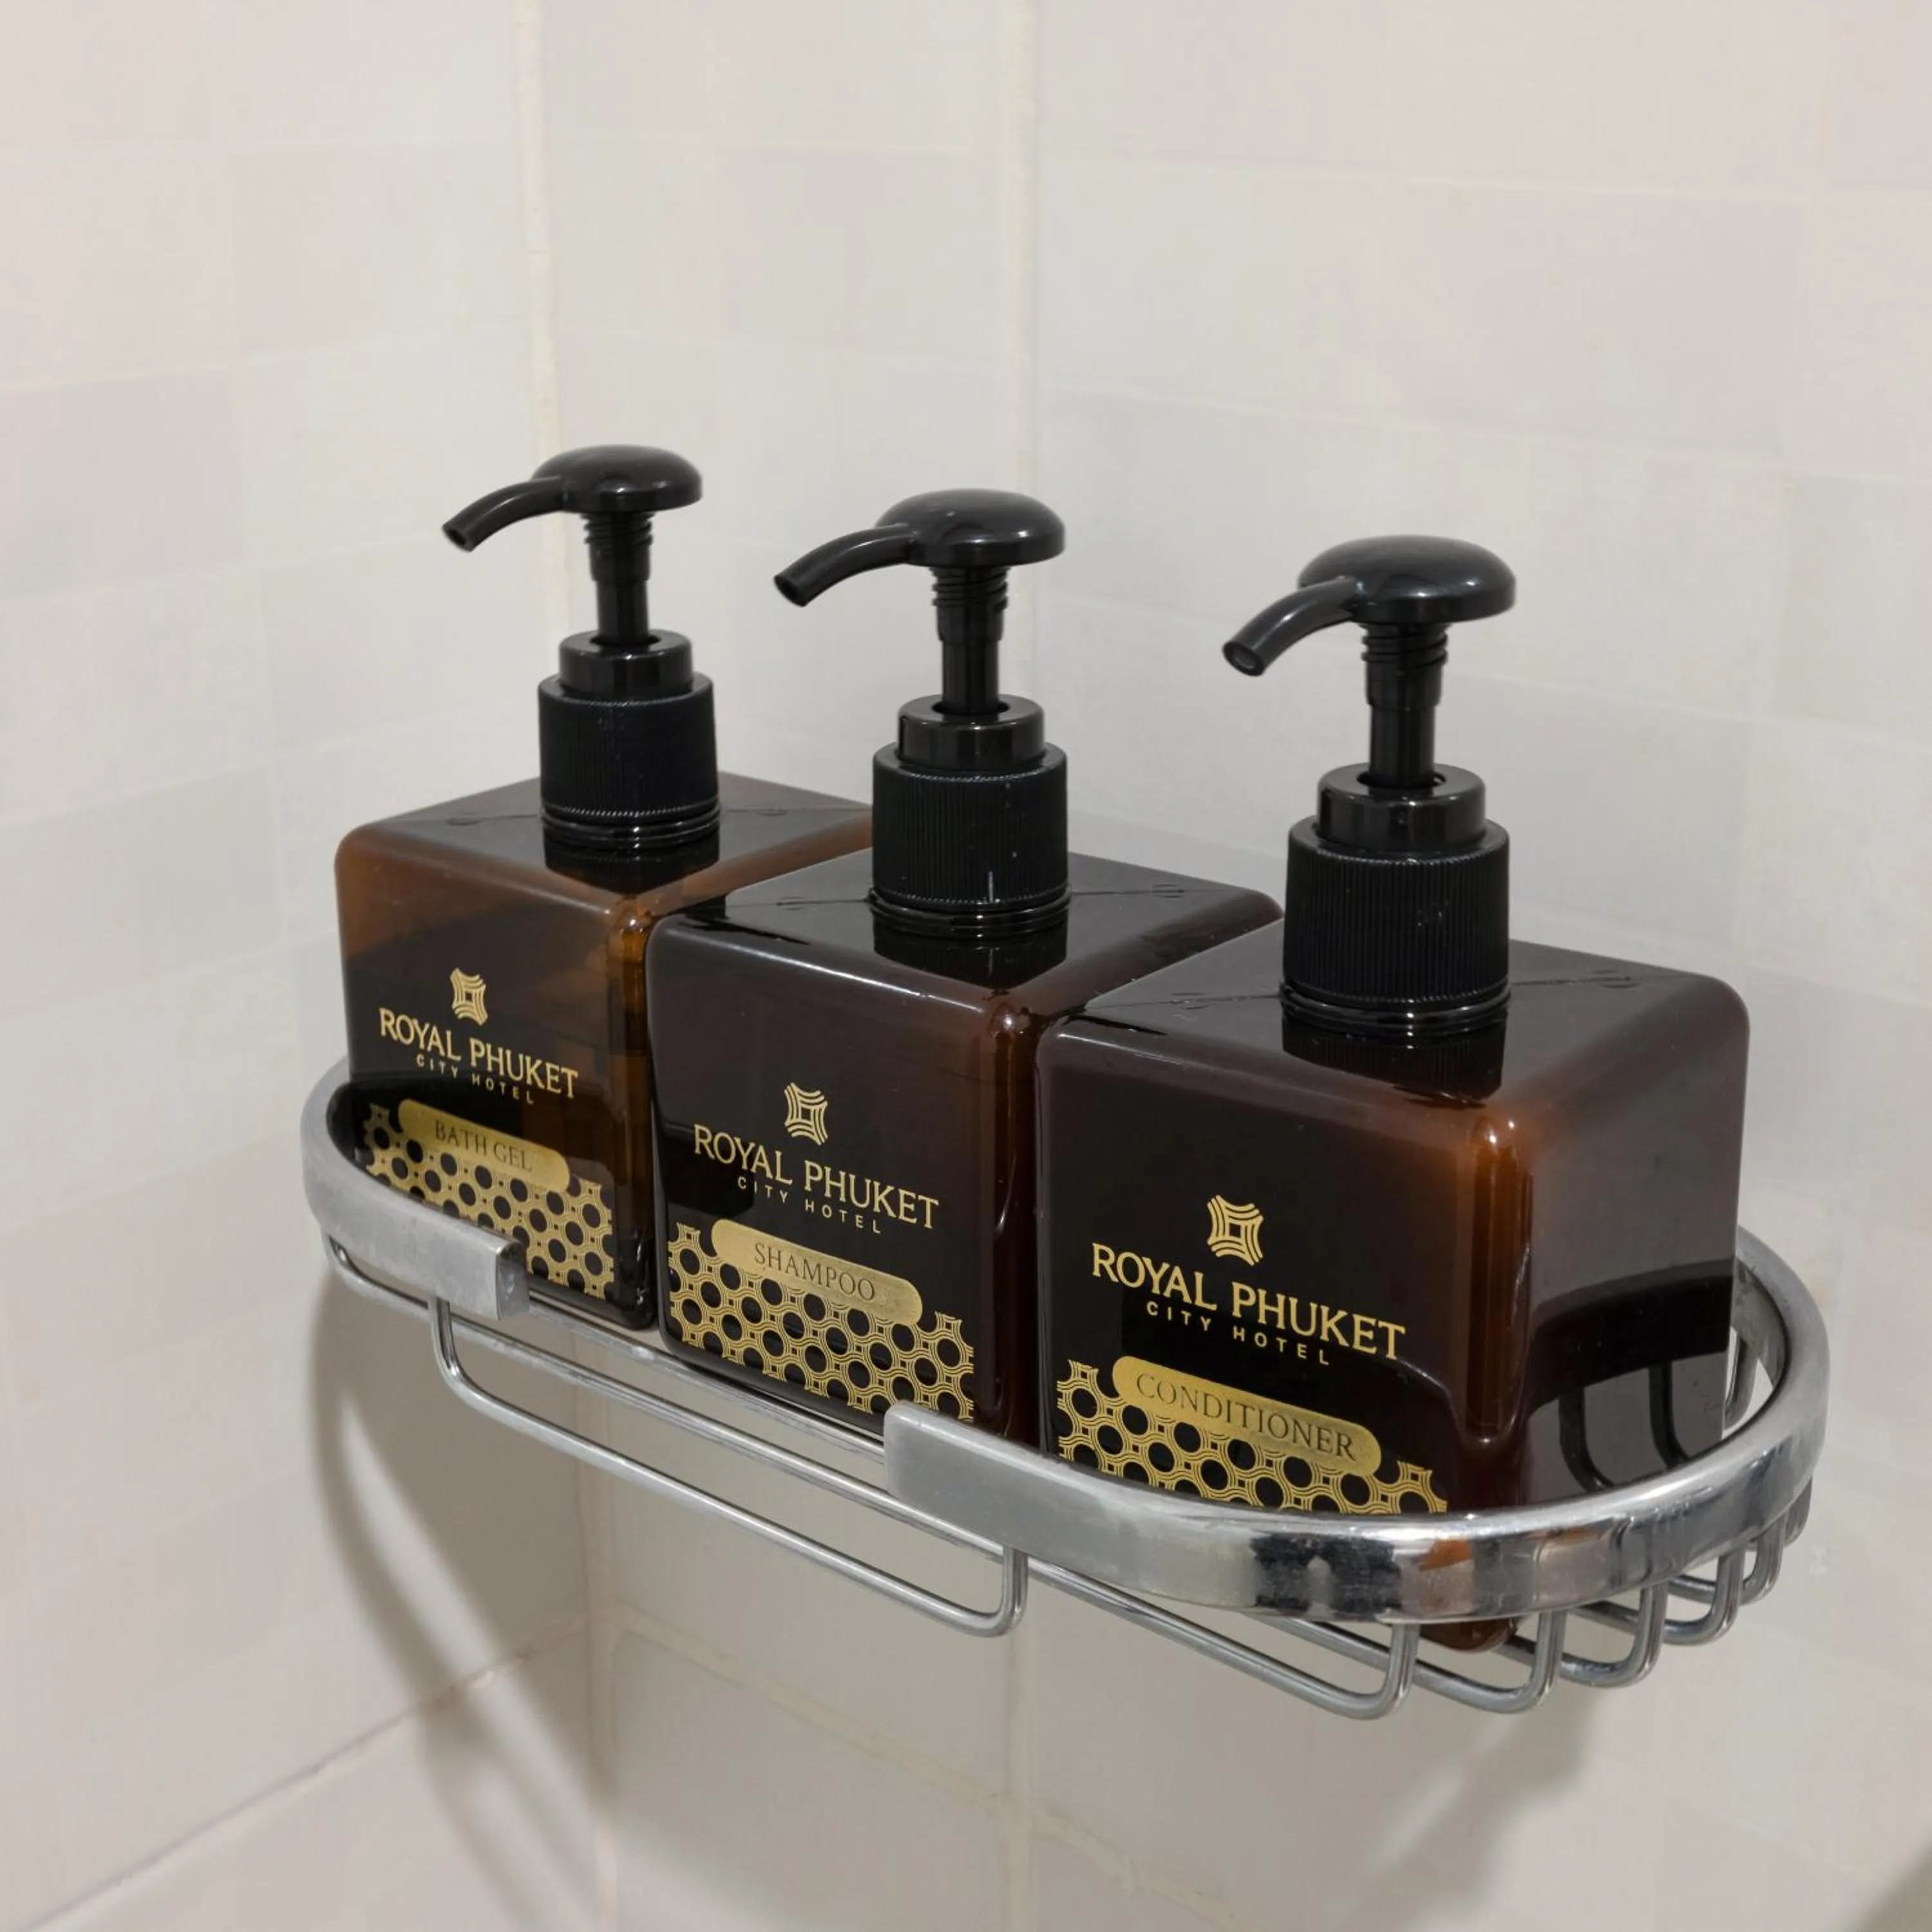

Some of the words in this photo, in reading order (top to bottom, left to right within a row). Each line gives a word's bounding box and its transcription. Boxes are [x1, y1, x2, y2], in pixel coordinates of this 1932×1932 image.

[379, 1008, 462, 1061] ROYAL
[470, 1037, 578, 1099] PHUKET
[417, 1054, 459, 1077] CITY
[472, 1075, 534, 1104] HOTEL
[435, 1120, 488, 1155] BATH
[493, 1142, 533, 1172] GEL
[694, 1124, 793, 1185] ROYAL
[804, 1160, 939, 1229] PHUKET
[737, 1177, 788, 1203] CITY
[806, 1199, 880, 1234] HOTEL
[754, 1242, 876, 1301] SHAMPOO
[1092, 1242, 1217, 1311] ROYAL
[1231, 1282, 1406, 1360] PHUKET
[1146, 1301, 1211, 1331] CITY
[1233, 1327, 1329, 1365] HOTEL
[1136, 1372, 1357, 1462] CONDITIONER
